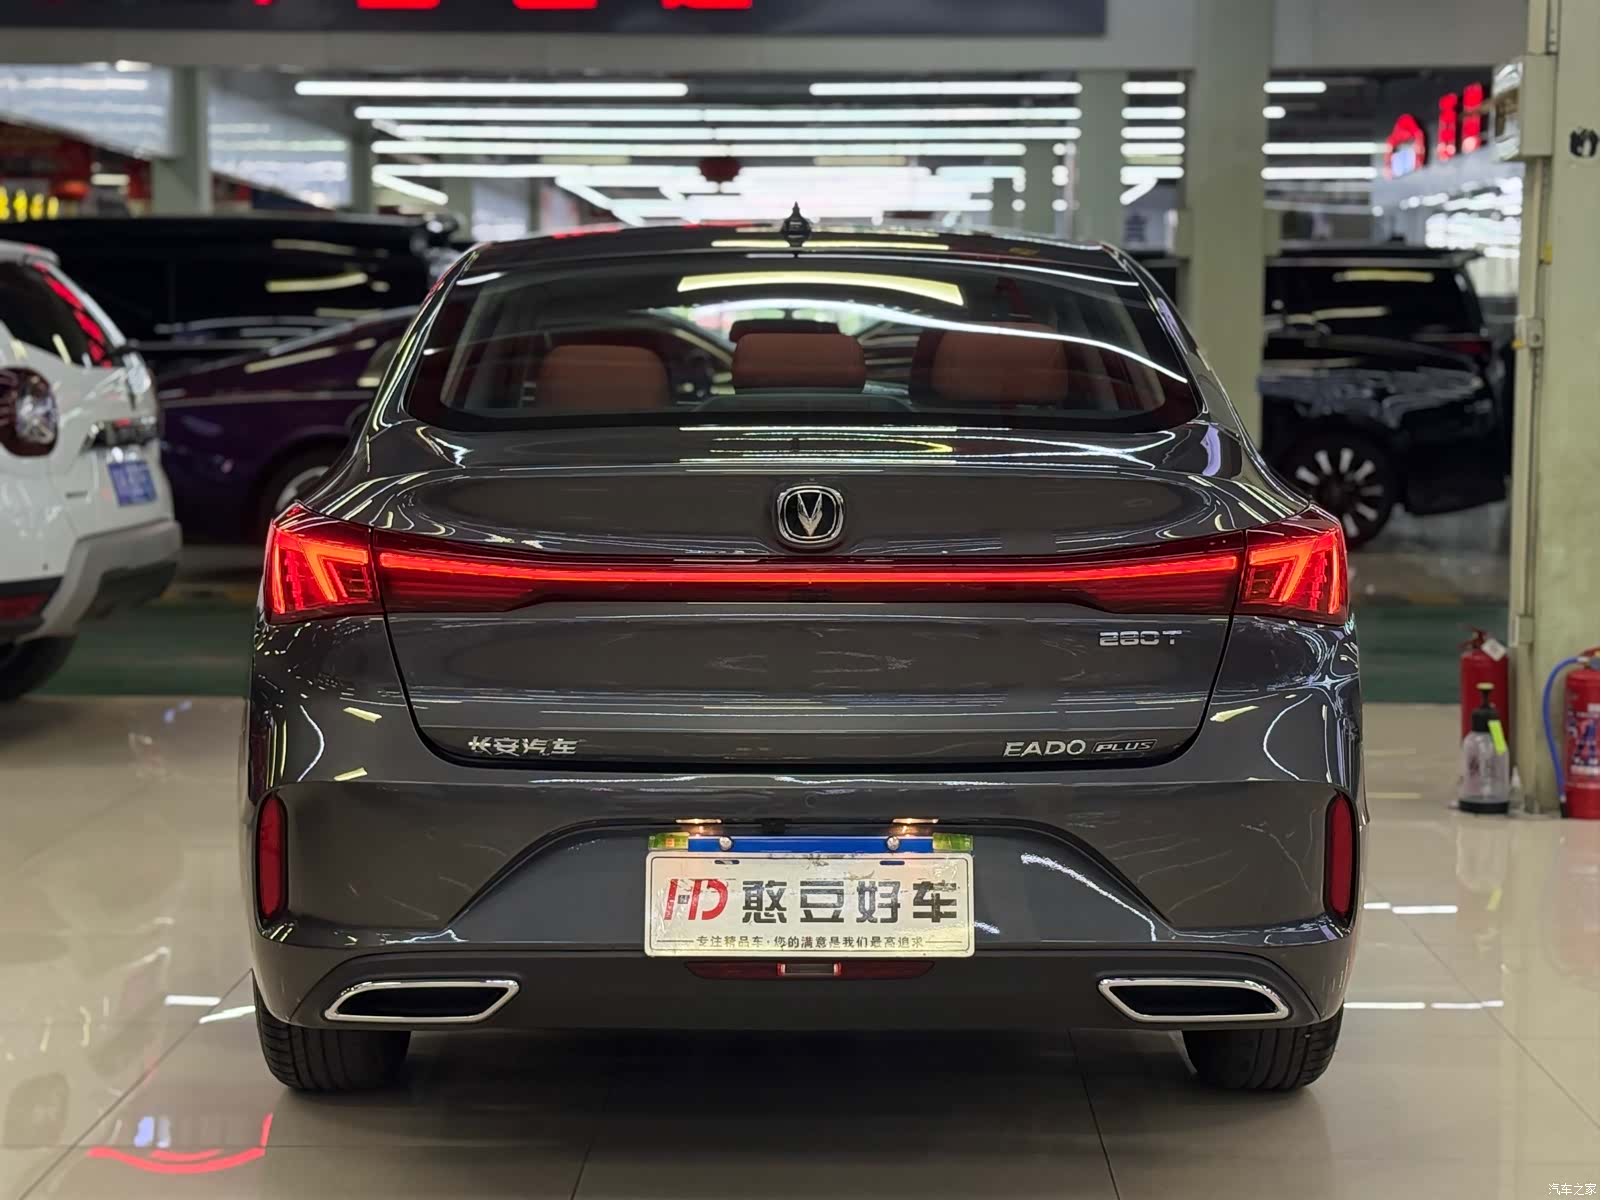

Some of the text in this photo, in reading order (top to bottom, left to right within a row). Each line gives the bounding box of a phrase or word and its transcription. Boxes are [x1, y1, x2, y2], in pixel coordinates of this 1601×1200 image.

[1099, 630, 1182, 646] 280T
[468, 736, 578, 757] 长安汽车
[1003, 739, 1153, 757] EADO PLUS
[742, 880, 957, 923] 憨豆好车
